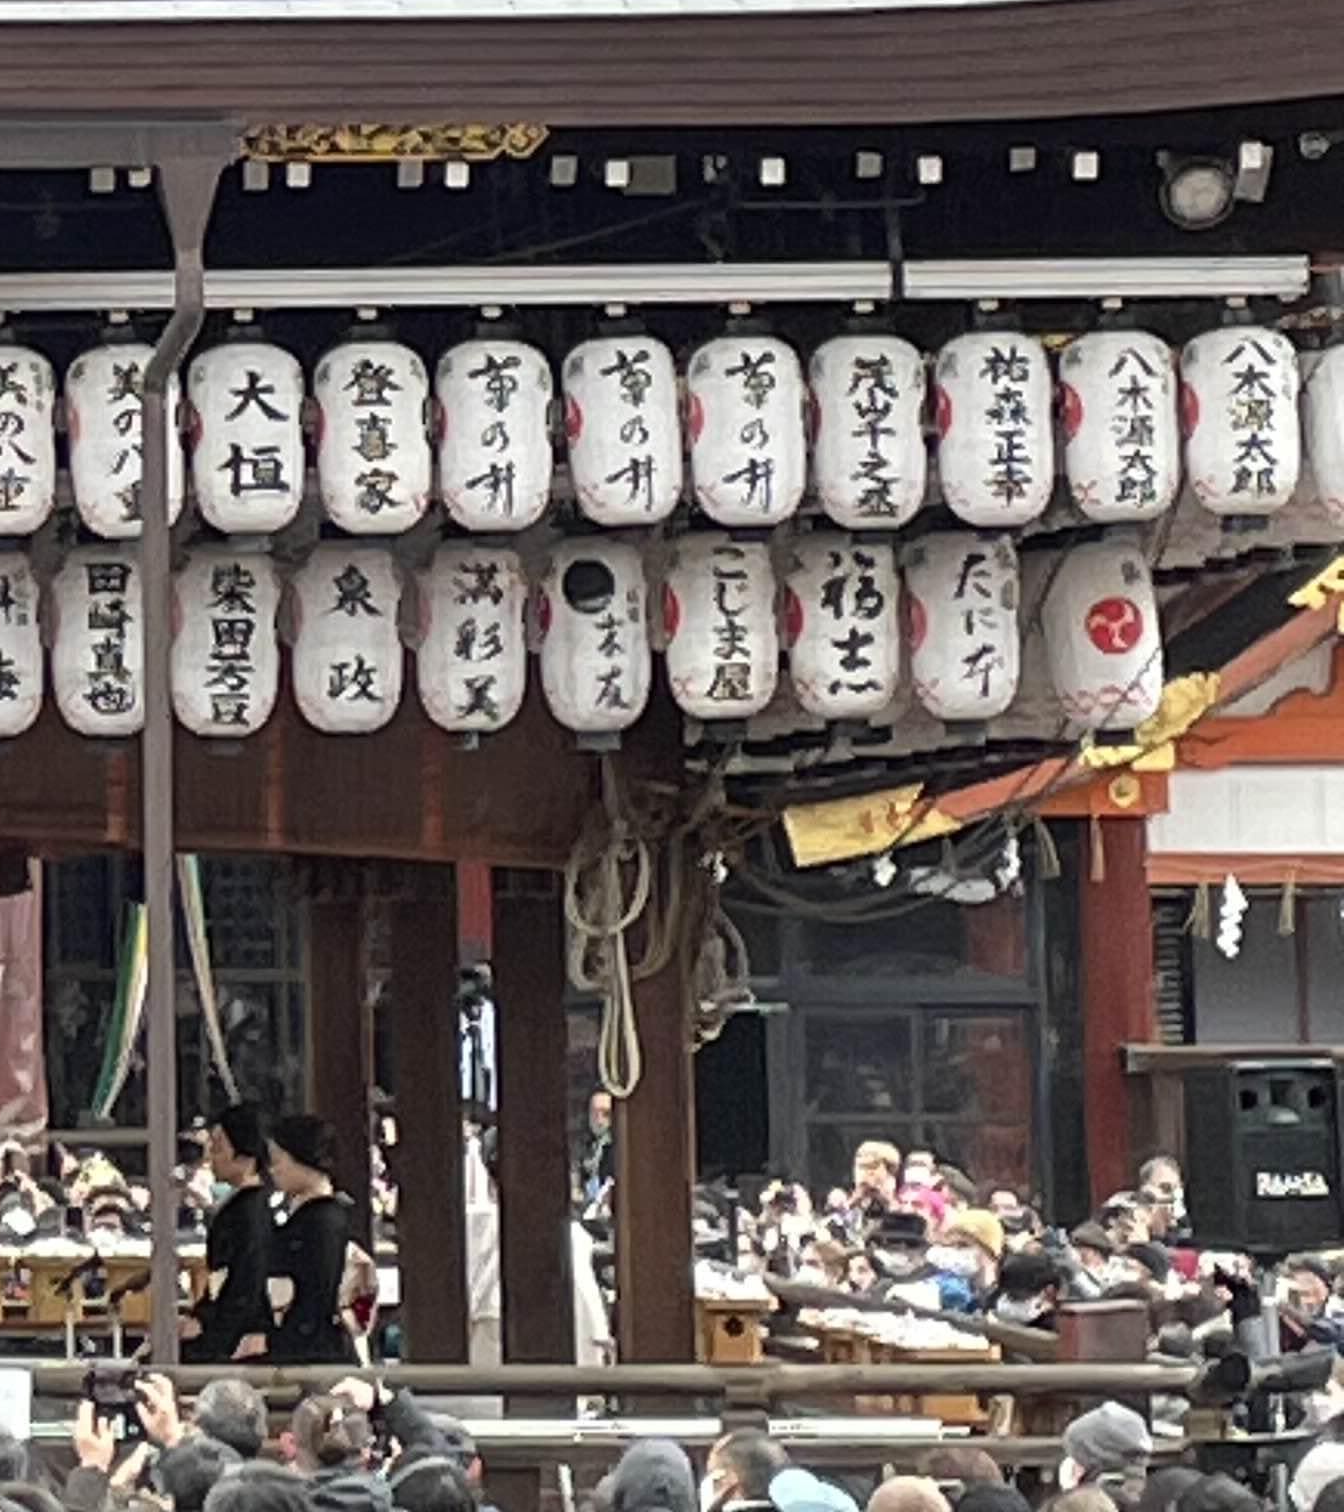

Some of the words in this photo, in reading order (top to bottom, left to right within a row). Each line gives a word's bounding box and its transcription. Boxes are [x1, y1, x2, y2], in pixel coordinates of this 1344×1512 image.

[1221, 336, 1277, 499] 八木源太郎
[83, 563, 136, 715] 田崎真也
[704, 547, 754, 700] こじま屋
